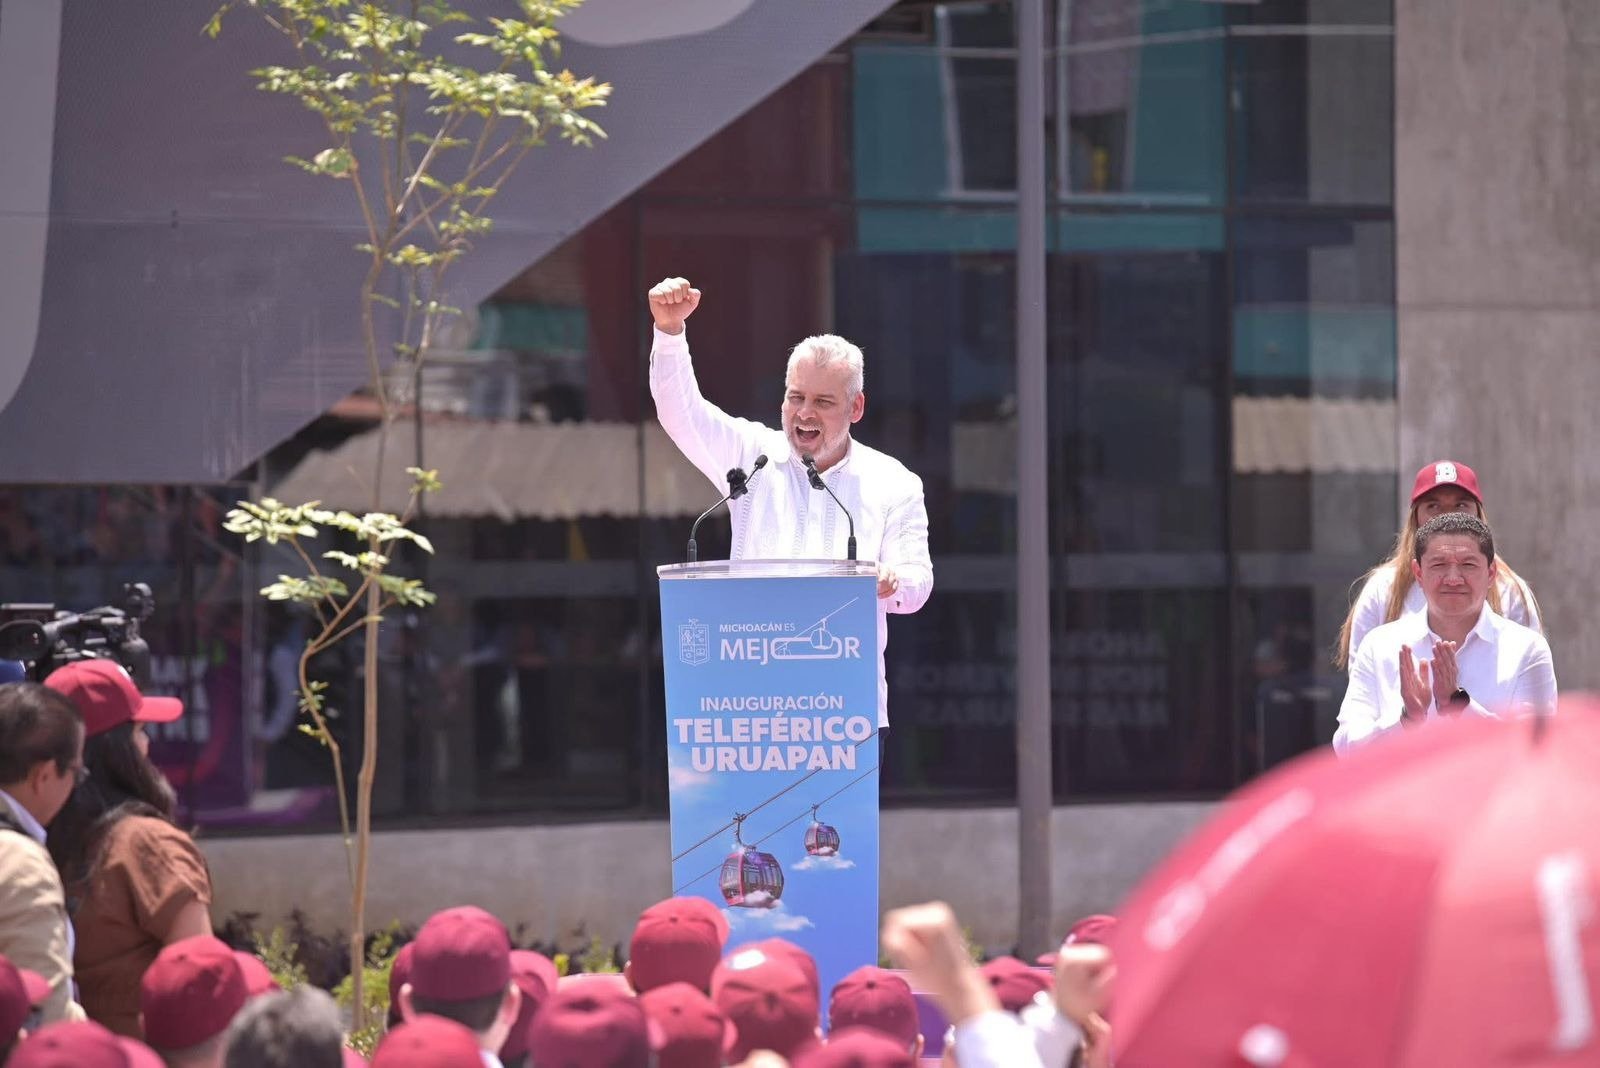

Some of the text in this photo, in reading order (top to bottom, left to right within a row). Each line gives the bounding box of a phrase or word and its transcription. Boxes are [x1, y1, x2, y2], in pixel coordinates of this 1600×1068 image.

[719, 622, 796, 633] MICHOACÁN ES
[720, 637, 861, 665] MEJOR
[700, 692, 843, 712] INAUGURACIÓN
[673, 711, 872, 744] TELEFÉRICO
[691, 745, 856, 772] URUAPAN
